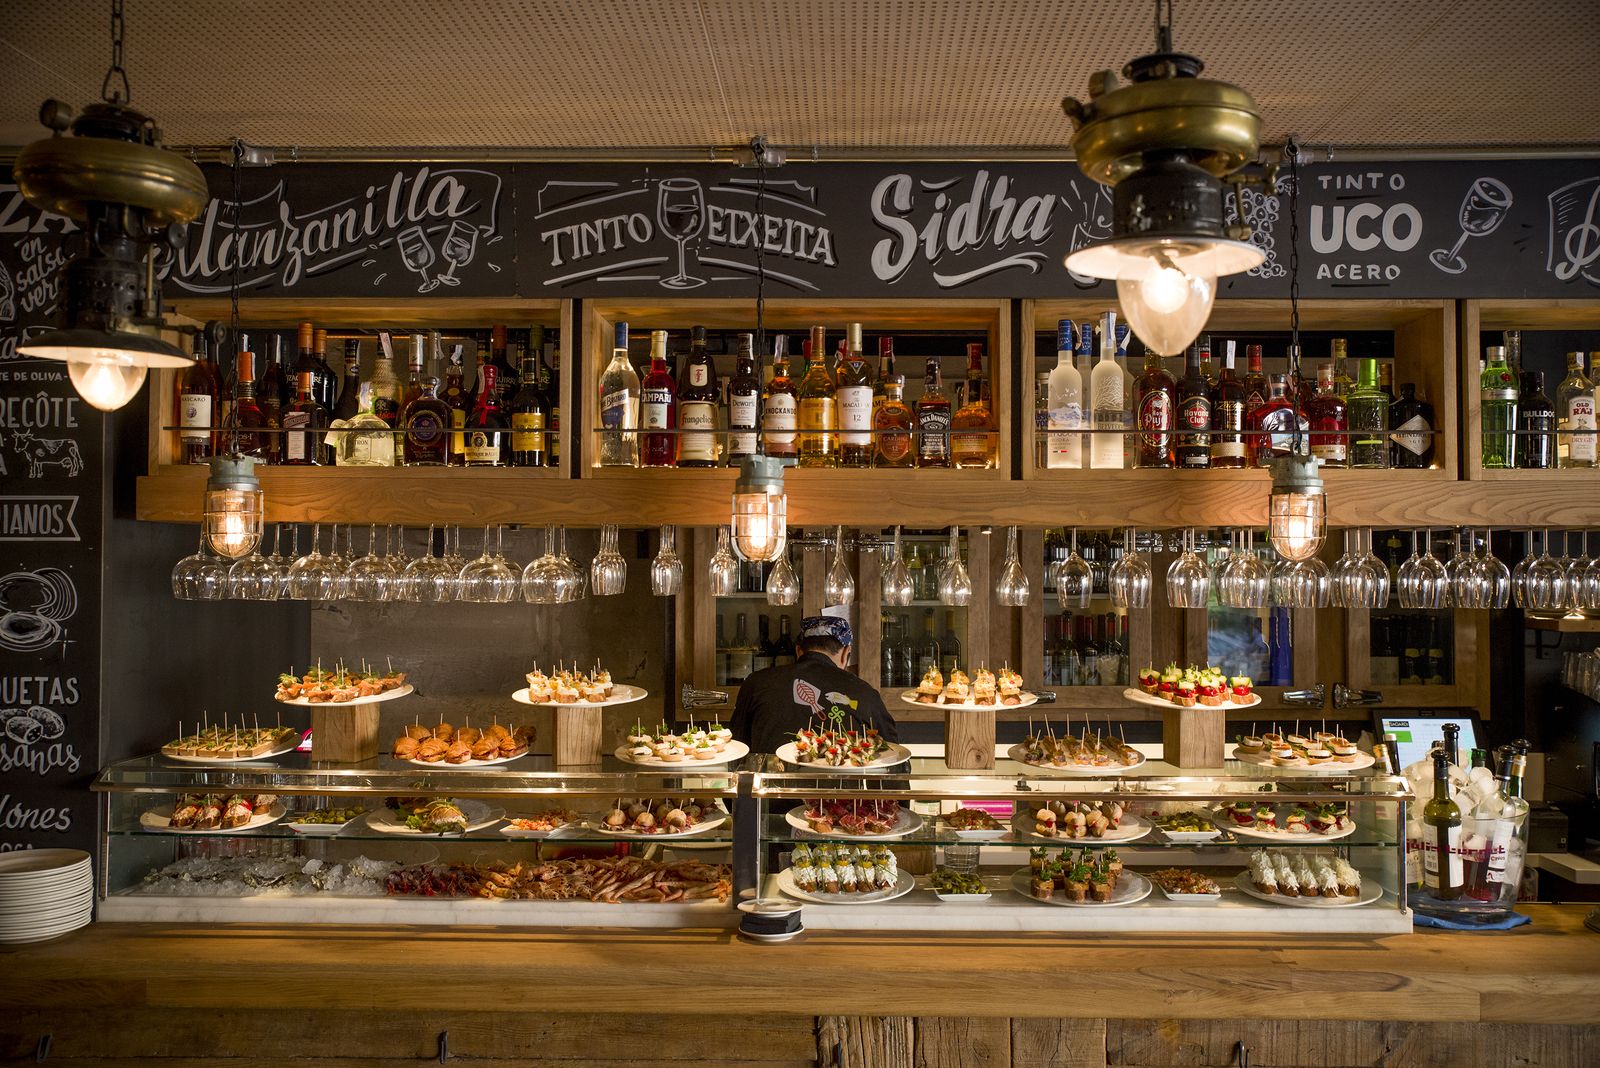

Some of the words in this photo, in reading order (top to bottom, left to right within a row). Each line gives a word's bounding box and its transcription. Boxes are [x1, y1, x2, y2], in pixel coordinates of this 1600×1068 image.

[1318, 173, 1405, 190] TINTO
[541, 213, 652, 266] TINTO
[707, 204, 837, 266] ETXEITA
[871, 169, 1056, 281] Sidra
[1310, 203, 1423, 253] UCO
[1317, 264, 1401, 280] ACERO
[14, 372, 28, 381] DE
[853, 414, 862, 422] 12
[0, 676, 79, 705] UETAS
